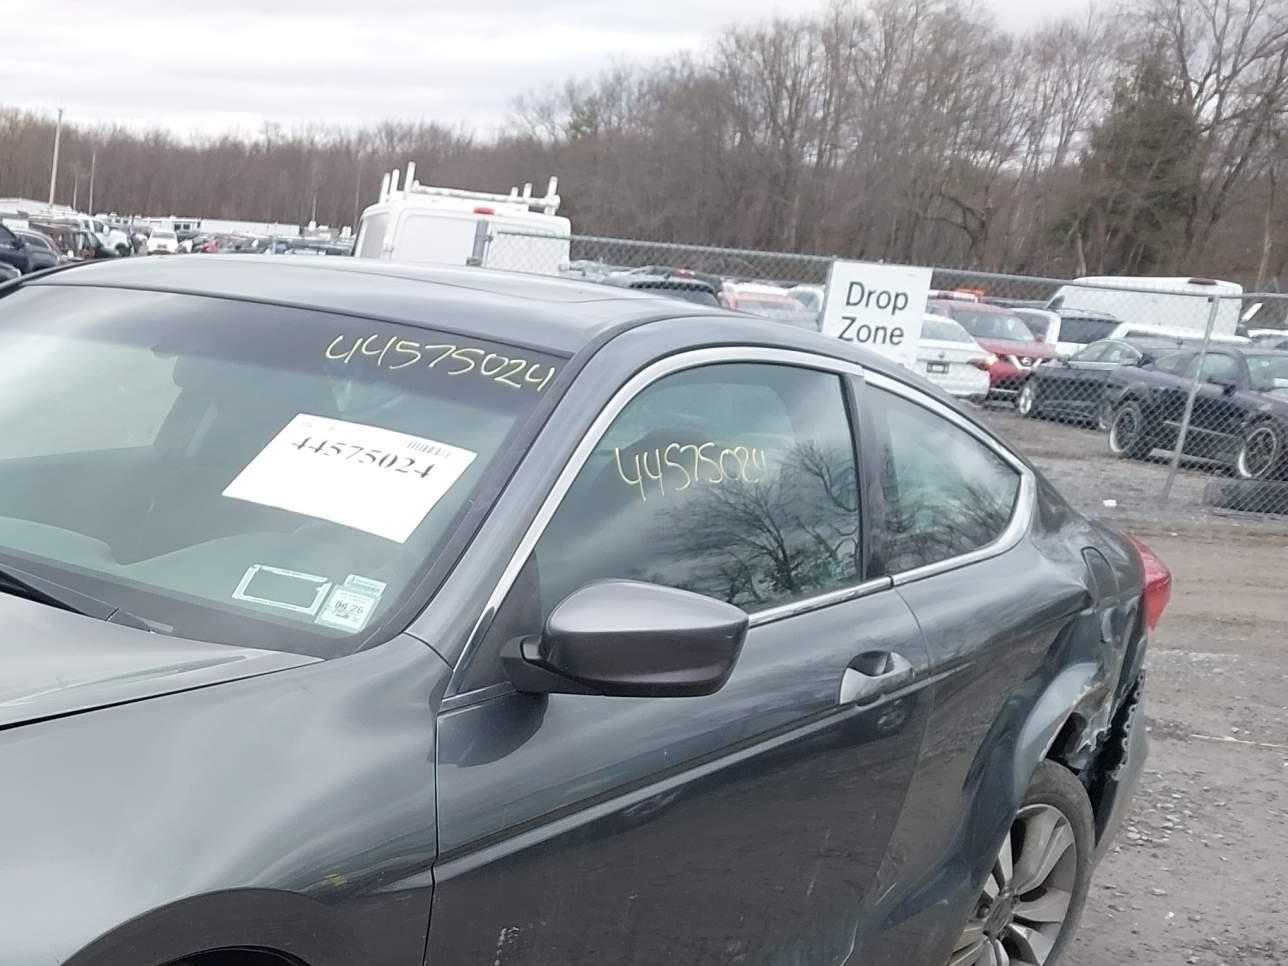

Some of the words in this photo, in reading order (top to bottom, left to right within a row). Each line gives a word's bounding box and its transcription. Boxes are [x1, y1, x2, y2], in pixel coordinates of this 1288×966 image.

[845, 281, 909, 316] Drop
[838, 316, 904, 346] Zone
[325, 334, 556, 392] 44575024
[290, 436, 435, 479] 44575024
[614, 442, 768, 503] 44575024
